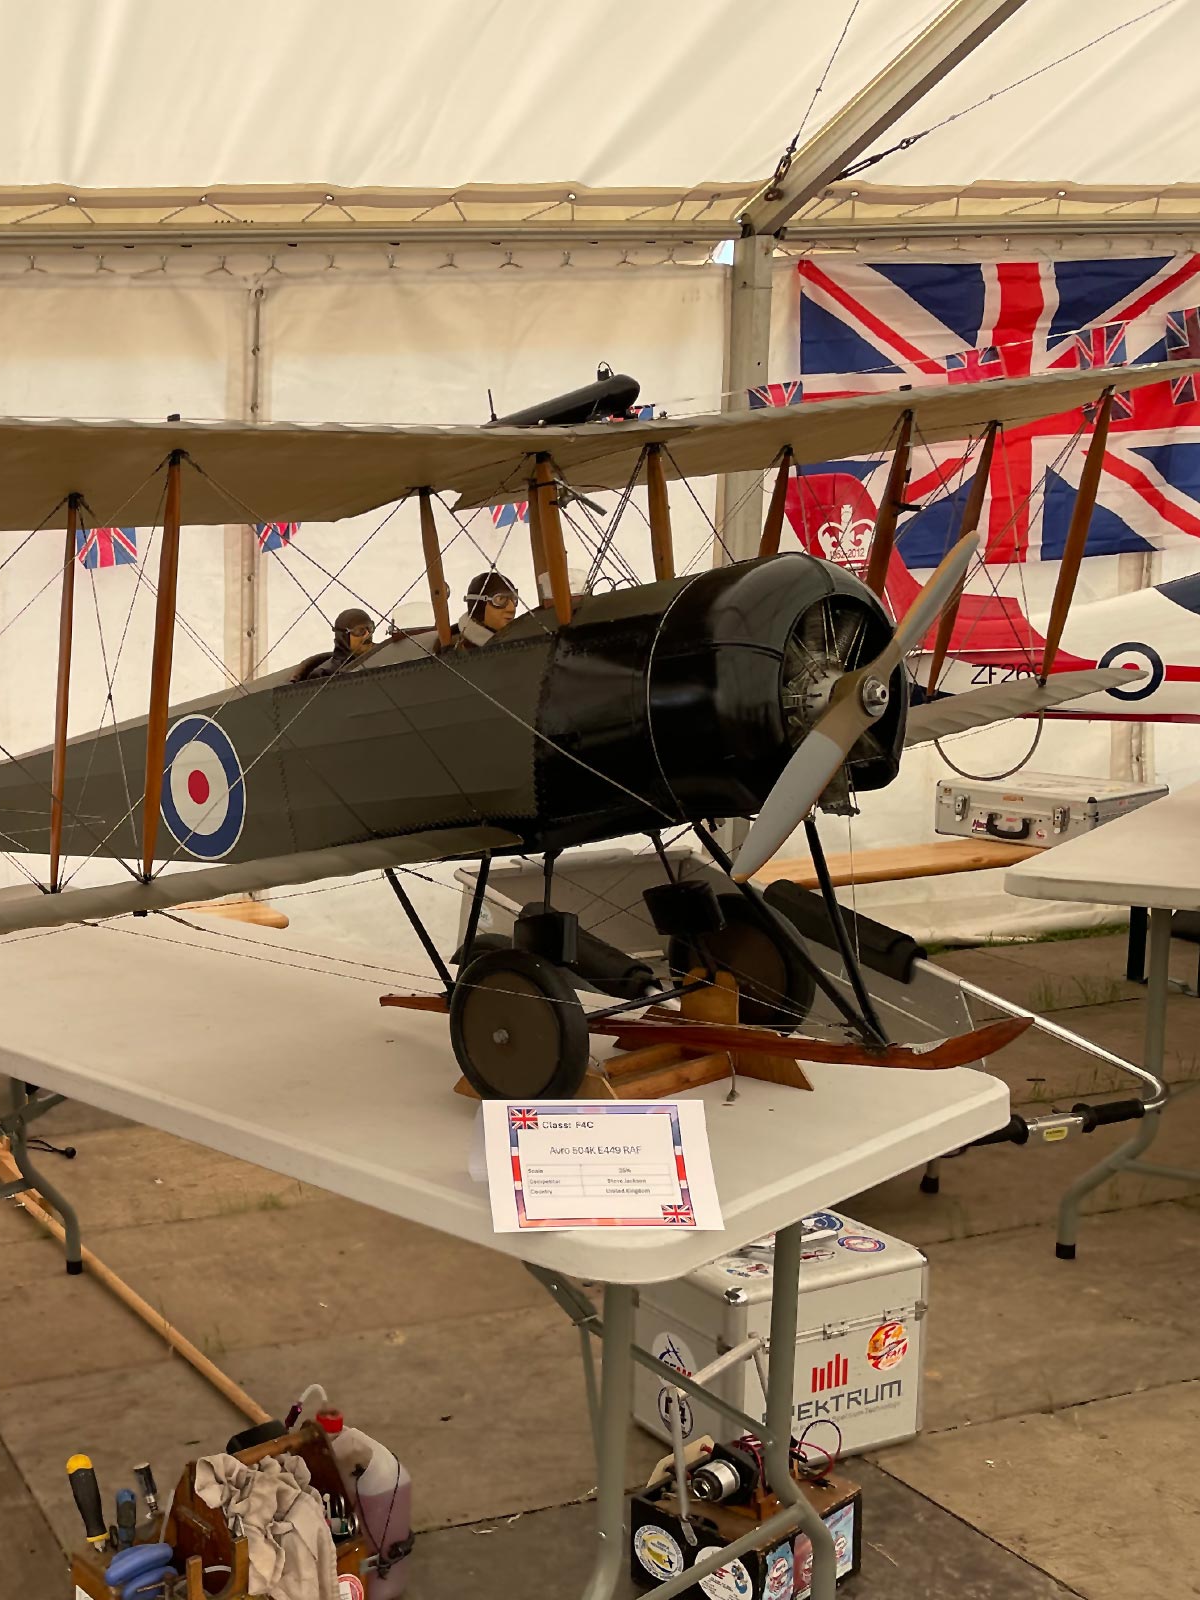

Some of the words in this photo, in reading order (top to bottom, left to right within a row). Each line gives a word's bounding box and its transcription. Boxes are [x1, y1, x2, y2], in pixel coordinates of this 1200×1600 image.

[542, 1121, 572, 1130] Class:
[575, 1121, 594, 1129] F4C
[550, 1146, 570, 1155] Avro
[572, 1146, 596, 1155] 504K
[598, 1146, 622, 1155] E449
[623, 1146, 642, 1155] RAF
[626, 1188, 651, 1196] Kingdom
[762, 1379, 902, 1426] EKTRUM
